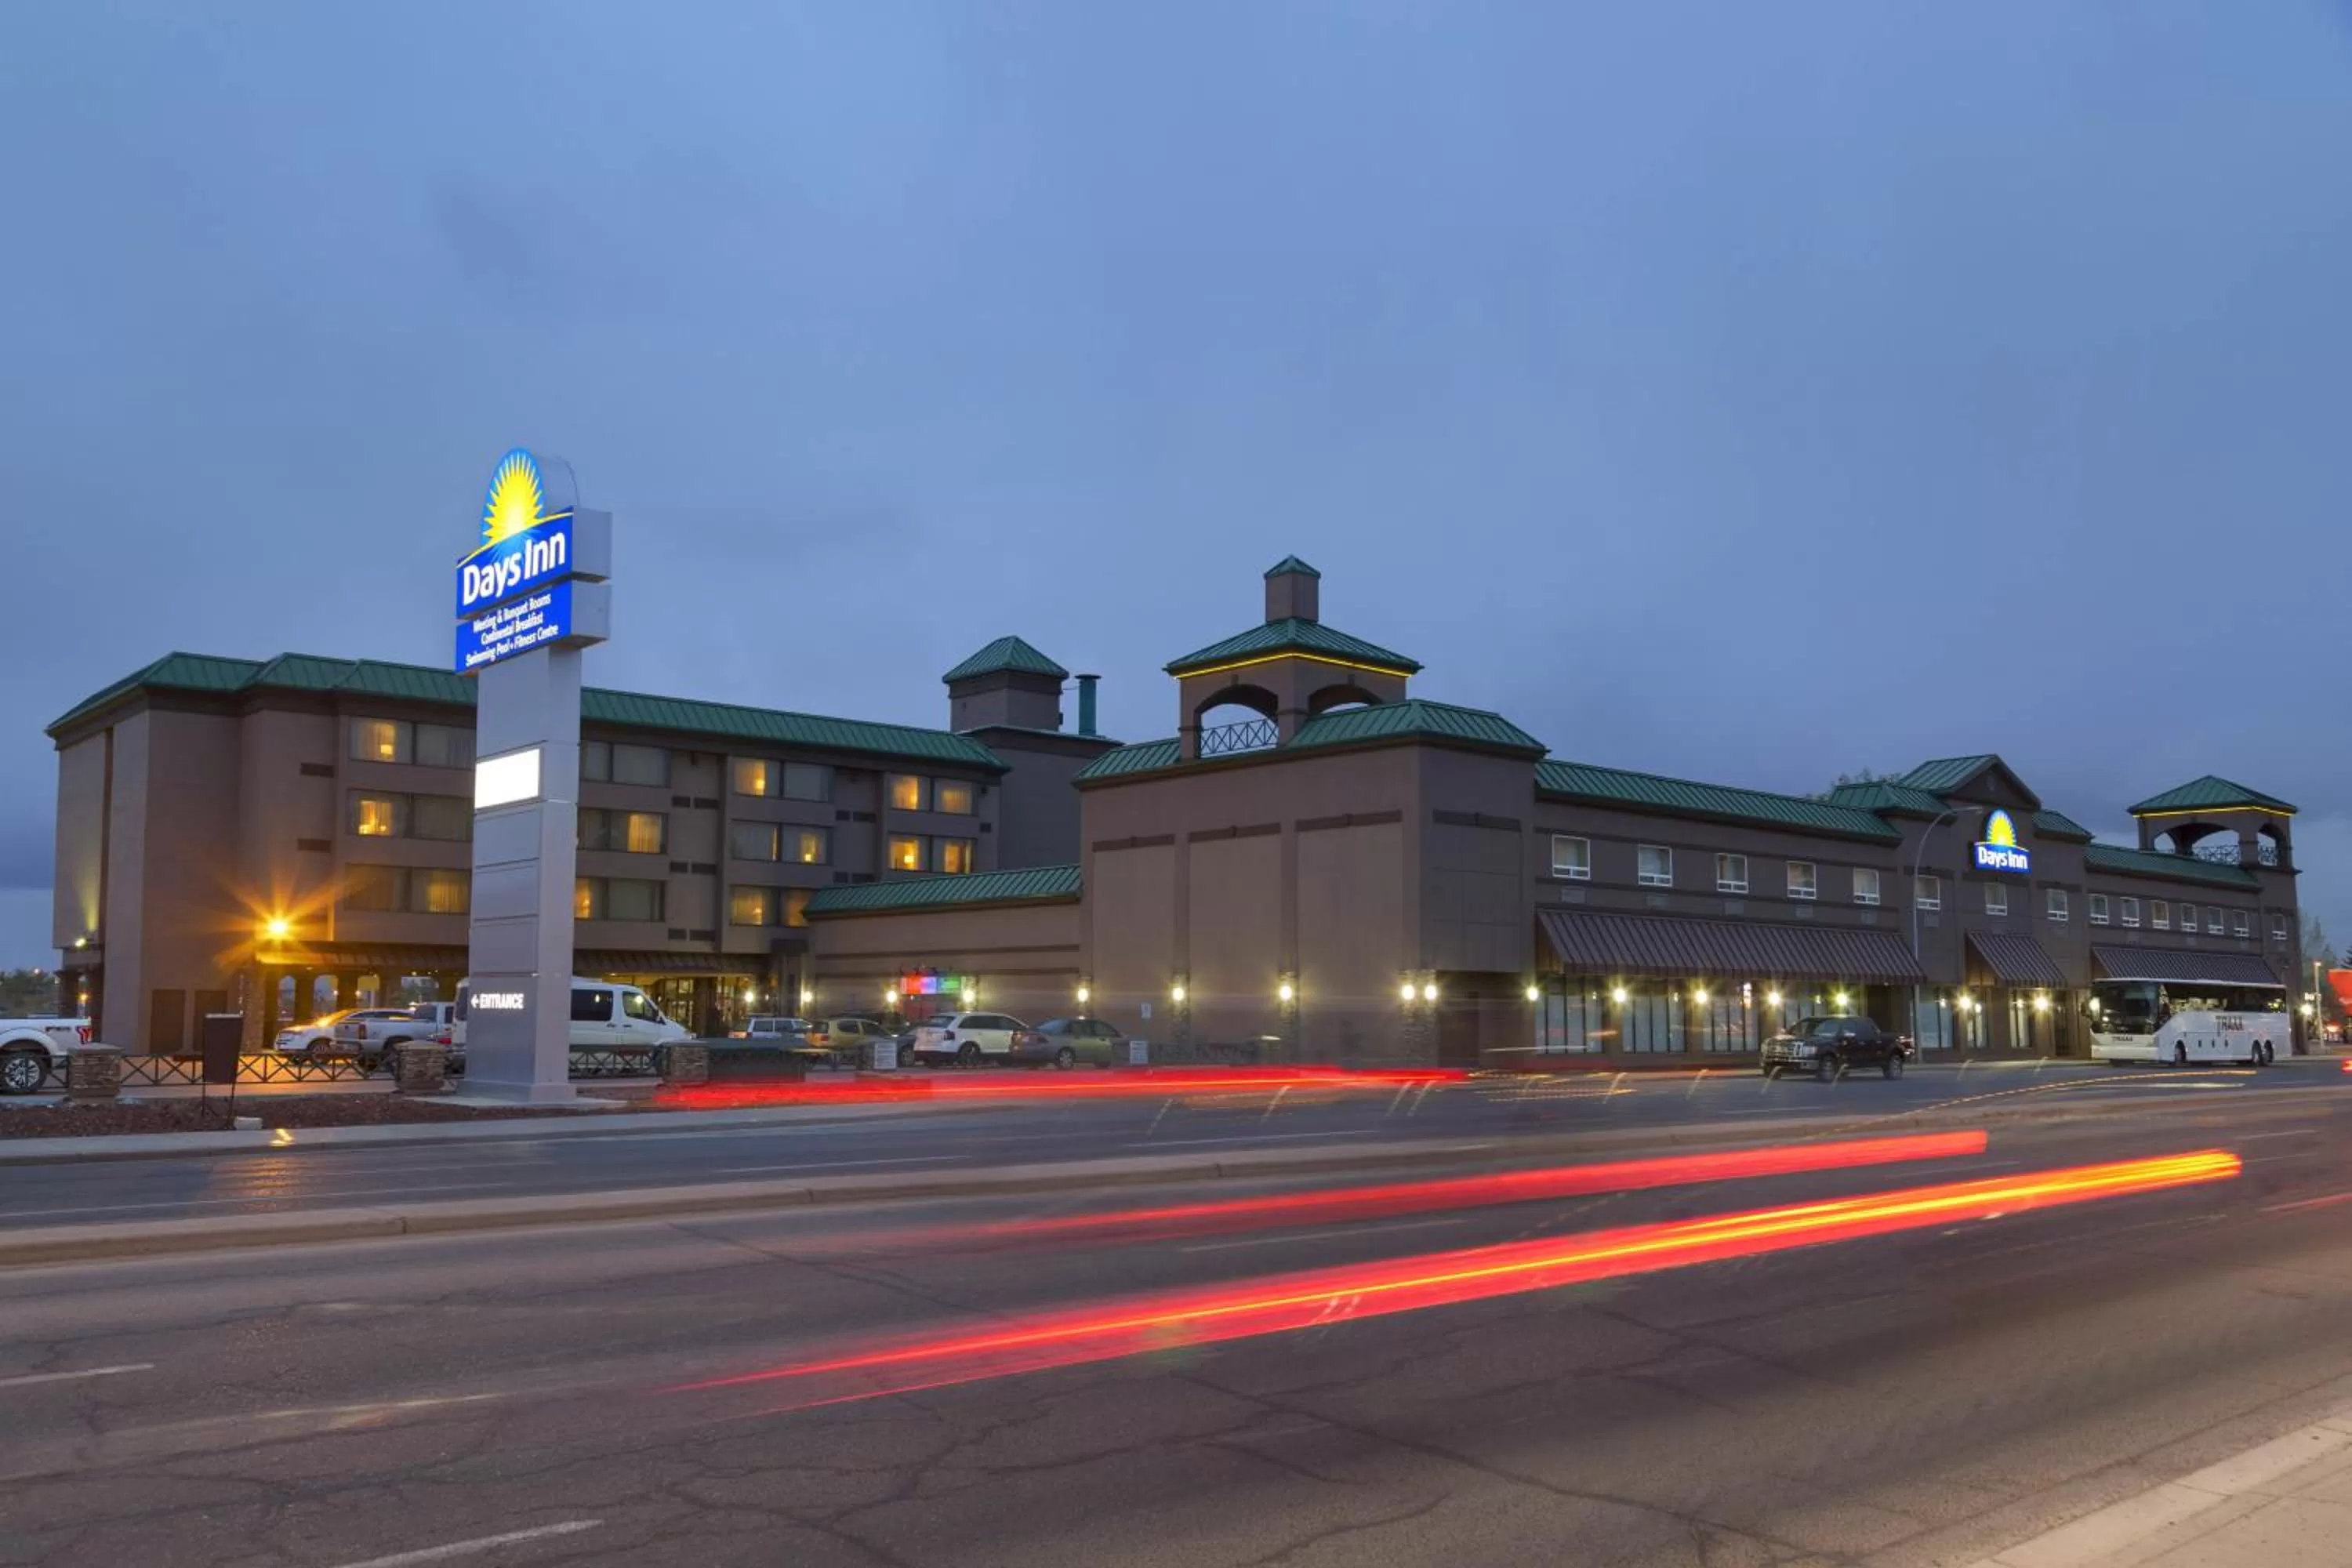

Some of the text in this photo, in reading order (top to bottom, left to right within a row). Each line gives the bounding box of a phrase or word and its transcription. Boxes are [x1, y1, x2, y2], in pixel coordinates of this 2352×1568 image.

[463, 532, 564, 604] Days Inn
[1978, 847, 2028, 869] Days Inn
[480, 993, 524, 1009] ENTRANCE
